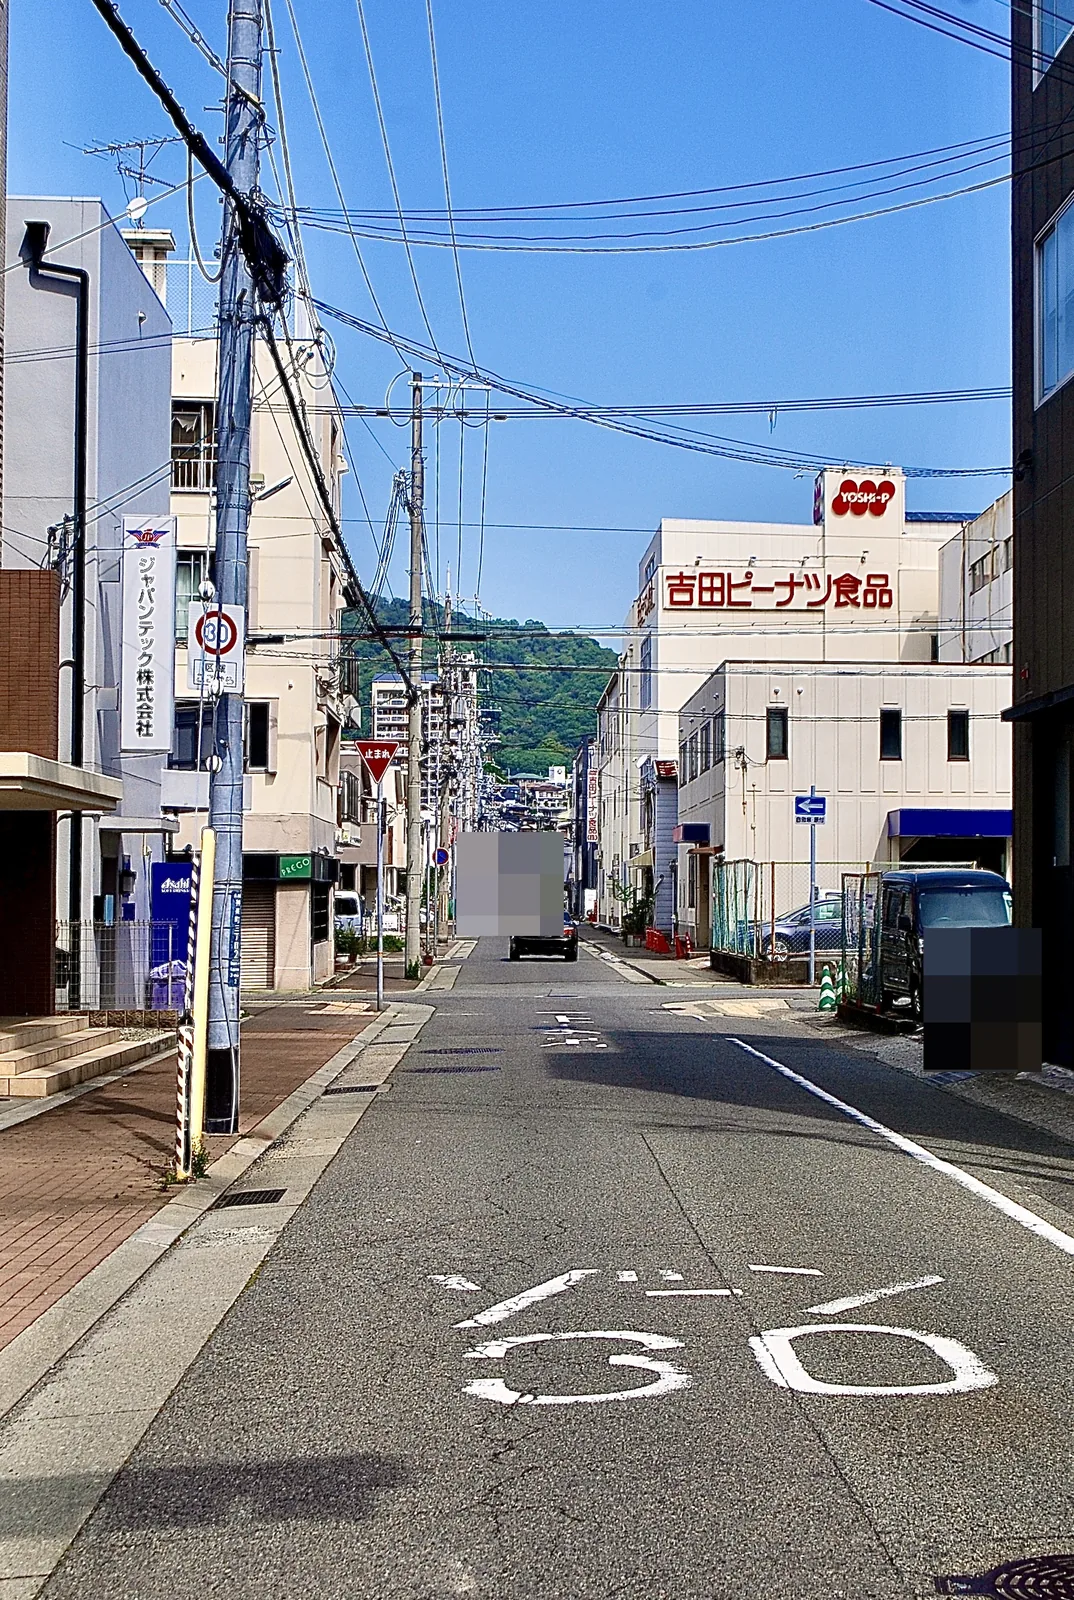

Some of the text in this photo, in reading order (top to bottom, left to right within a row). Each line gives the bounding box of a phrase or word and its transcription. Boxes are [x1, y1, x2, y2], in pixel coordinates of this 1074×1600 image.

[665, 570, 893, 608] 吉田ピーナツ食品
[136, 556, 156, 738] ジャパンテック株式会社
[204, 622, 228, 643] 30
[364, 748, 391, 759] 止まれ
[281, 858, 310, 876] PREGO
[161, 877, 190, 889] Asahi
[427, 1264, 945, 1329] ゾーン
[461, 1323, 999, 1405] 30
